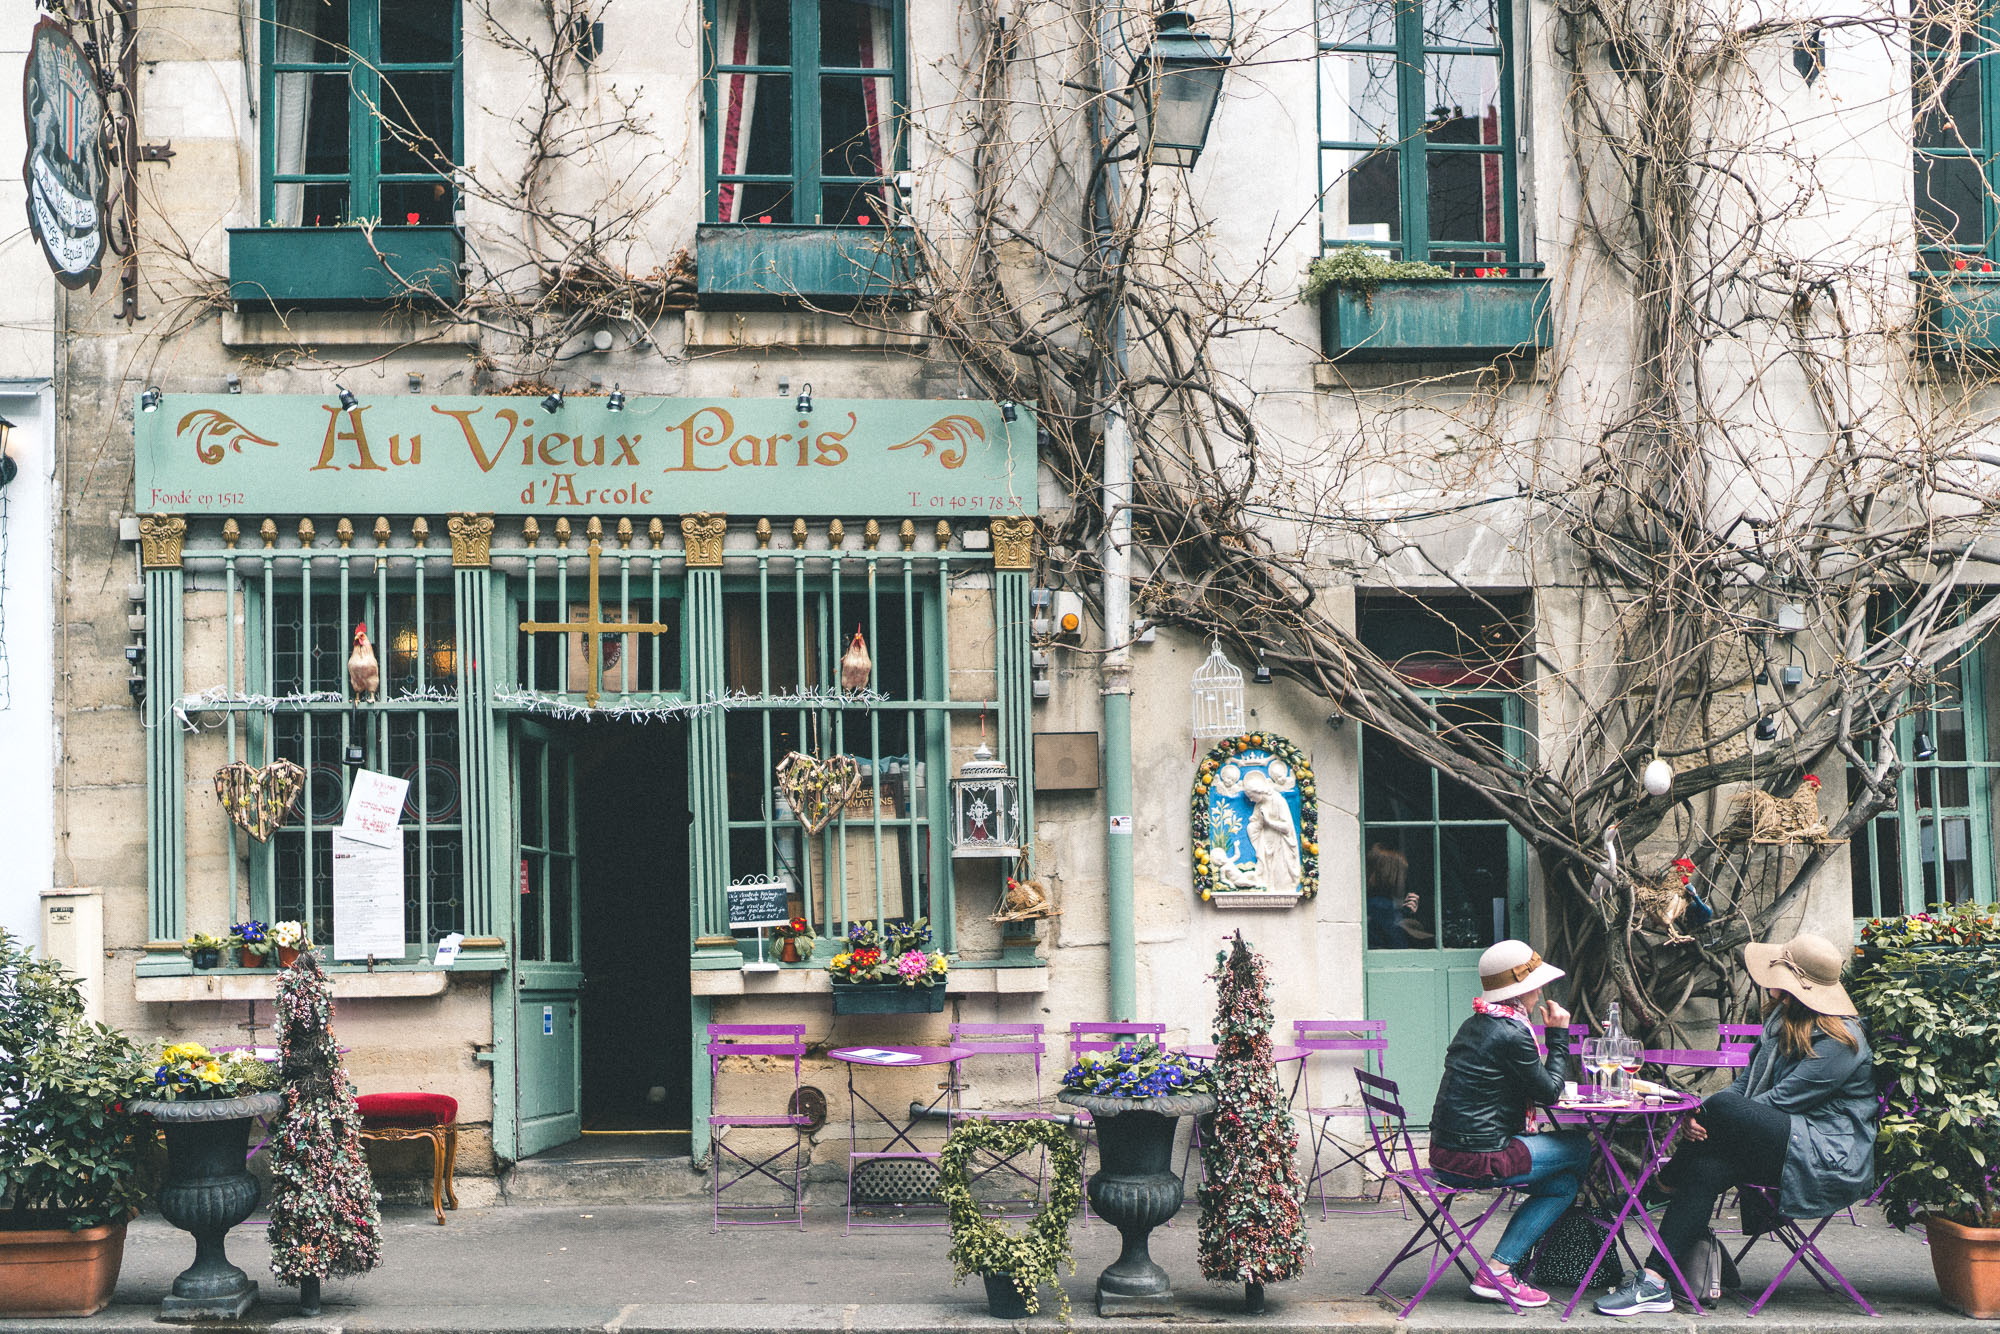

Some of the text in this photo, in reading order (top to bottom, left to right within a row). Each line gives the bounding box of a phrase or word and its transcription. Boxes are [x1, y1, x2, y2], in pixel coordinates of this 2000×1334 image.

[309, 404, 857, 473] Au Vieux Paris
[148, 488, 245, 510] Fondé en 1512
[520, 472, 653, 507] d'Arcole
[930, 496, 944, 507] 01
[949, 496, 967, 511] 40
[969, 496, 983, 511] 51
[989, 496, 1004, 511] 78
